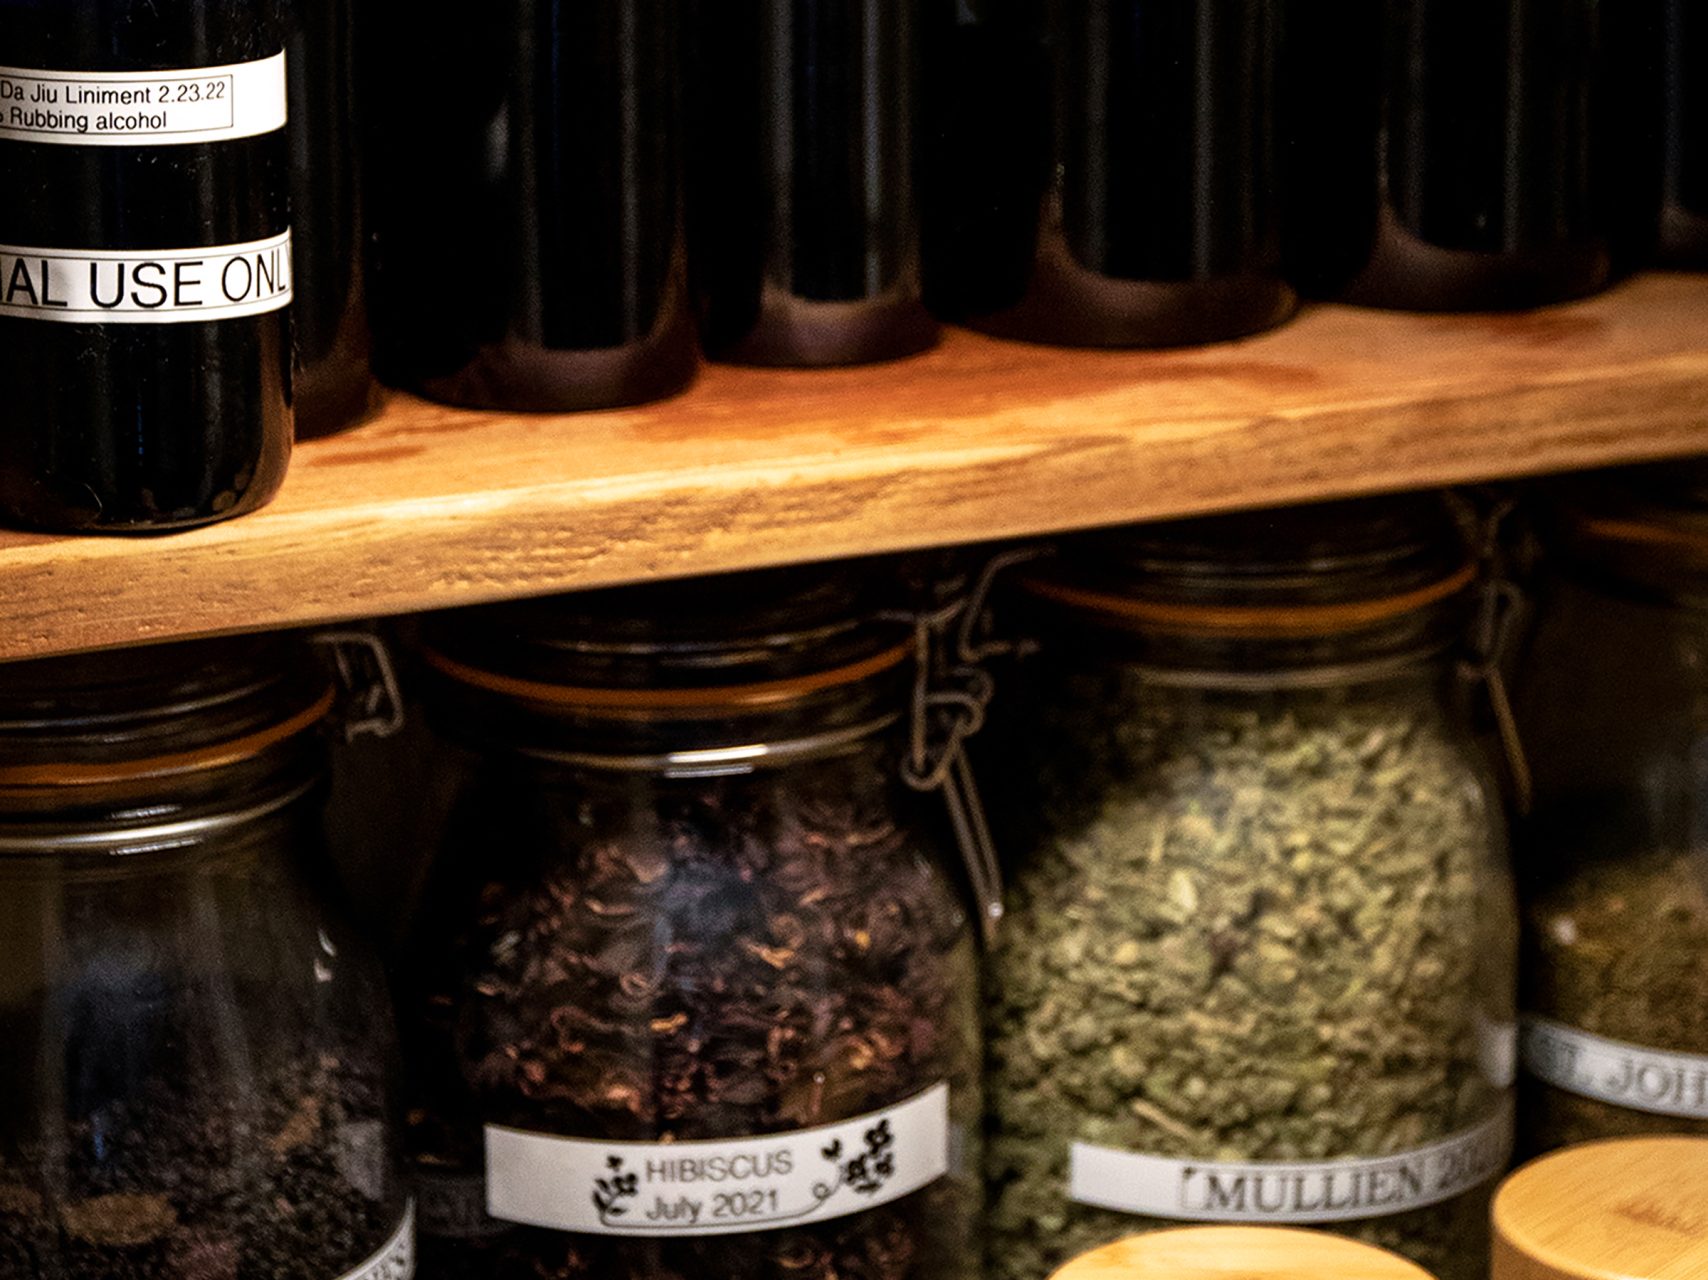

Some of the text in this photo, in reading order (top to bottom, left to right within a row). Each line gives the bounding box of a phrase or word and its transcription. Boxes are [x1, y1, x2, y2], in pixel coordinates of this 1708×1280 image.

[0, 80, 226, 105] Da Jiu Liniment 2.23.22
[10, 106, 89, 133] Rubbing
[96, 111, 167, 130] alcohol
[0, 257, 68, 307] AL
[90, 260, 204, 309] USE
[646, 1149, 794, 1183] HIBISCUS
[1204, 1162, 1425, 1214] MULLIEN
[646, 1188, 779, 1224] July 2021
